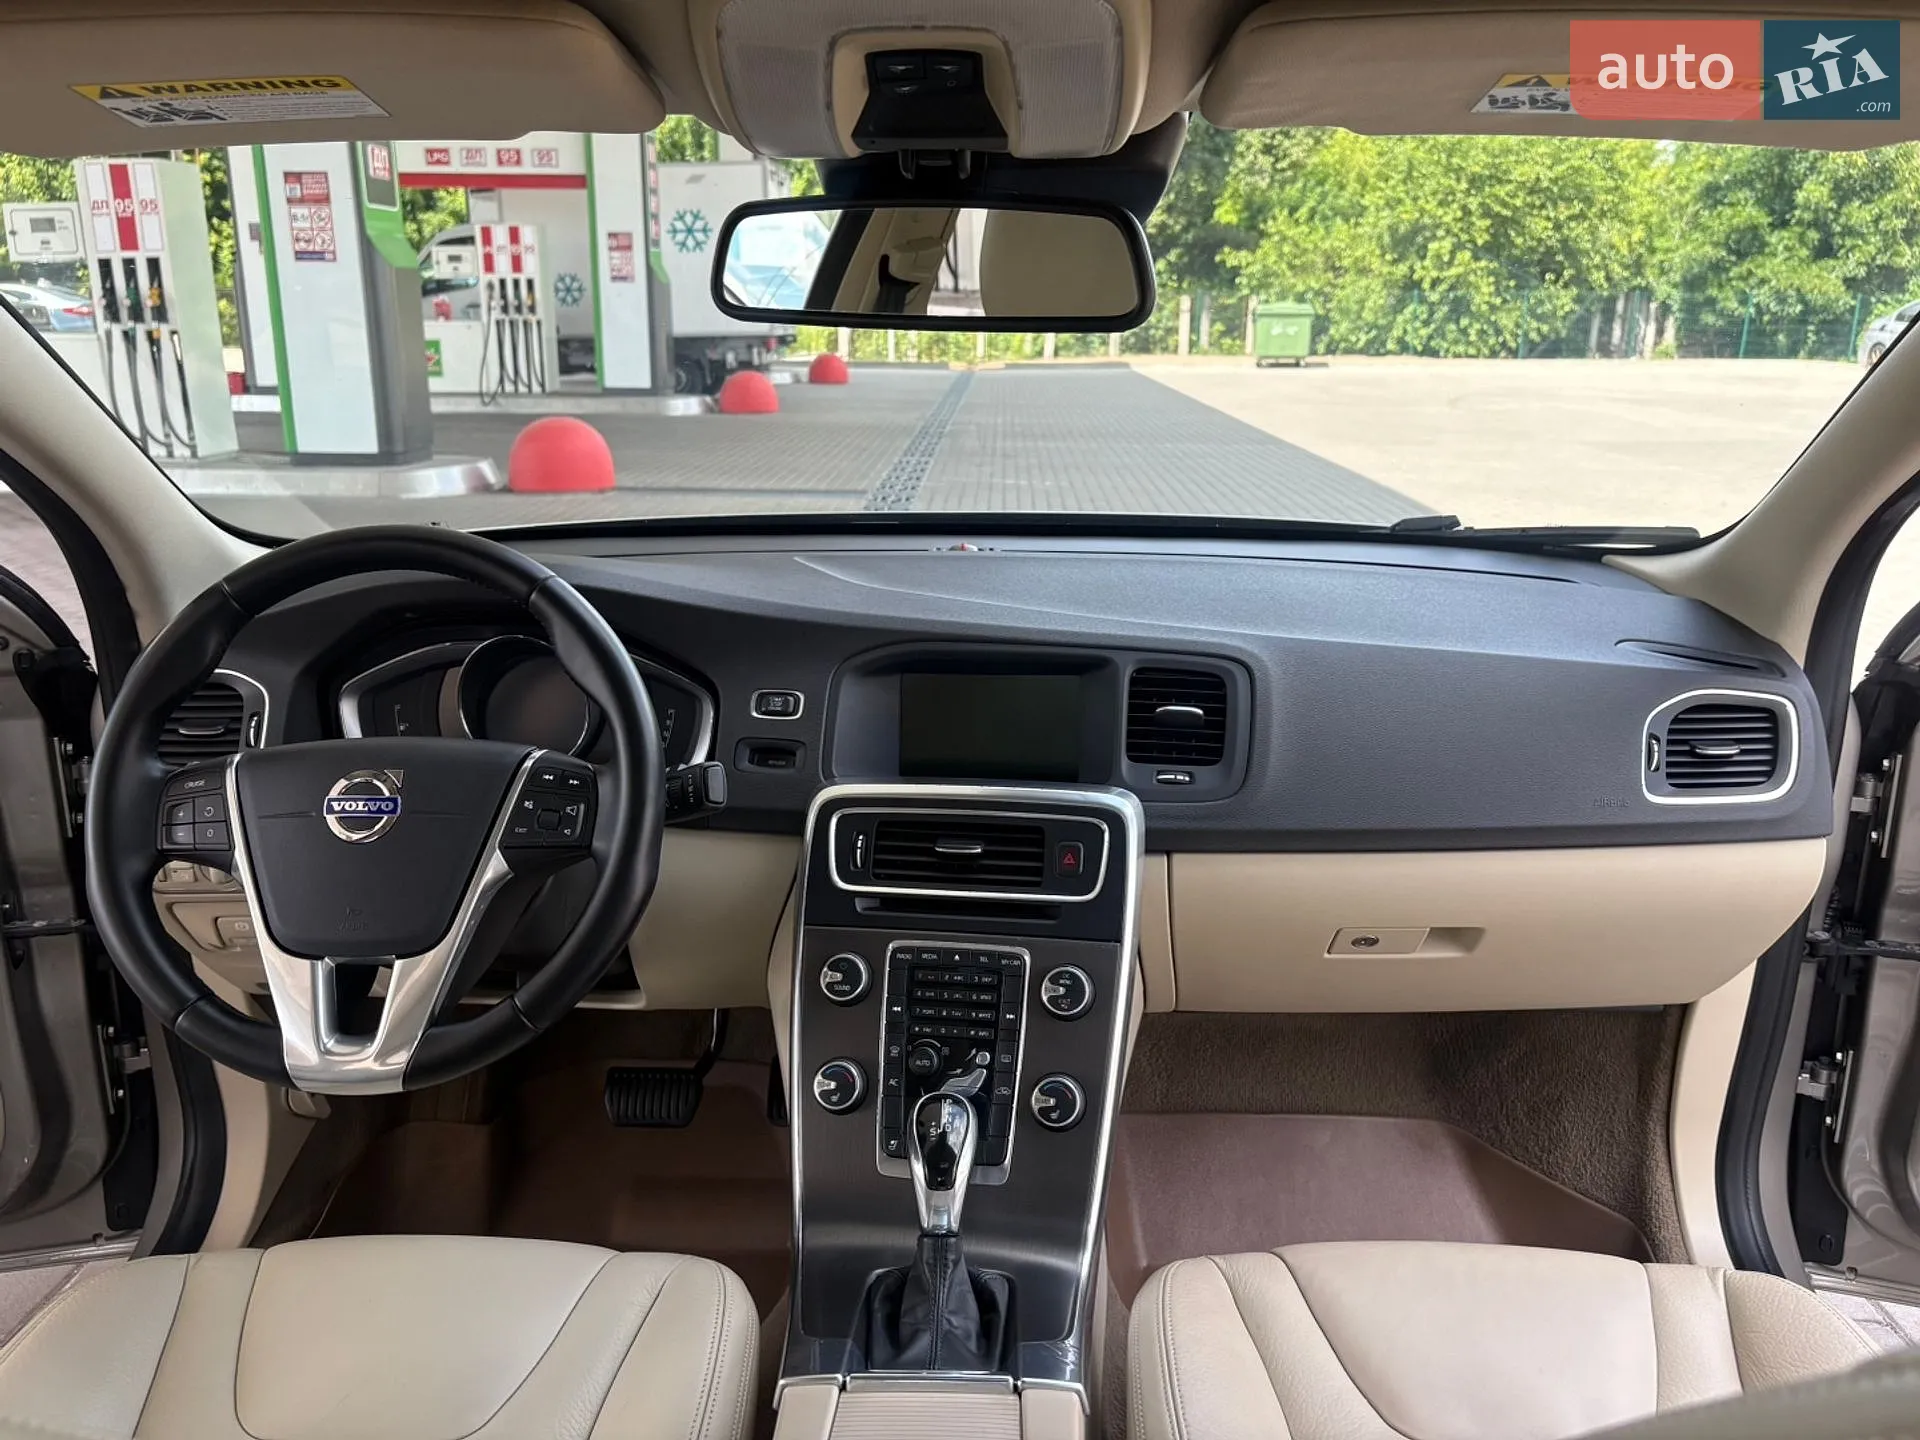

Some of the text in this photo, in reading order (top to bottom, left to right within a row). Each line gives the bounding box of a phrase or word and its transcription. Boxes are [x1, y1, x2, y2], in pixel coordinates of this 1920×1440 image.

[139, 79, 342, 94] WARNING
[500, 149, 518, 161] 95
[114, 198, 134, 213] 95
[139, 198, 159, 212] 95
[331, 801, 394, 811] VOLVO
